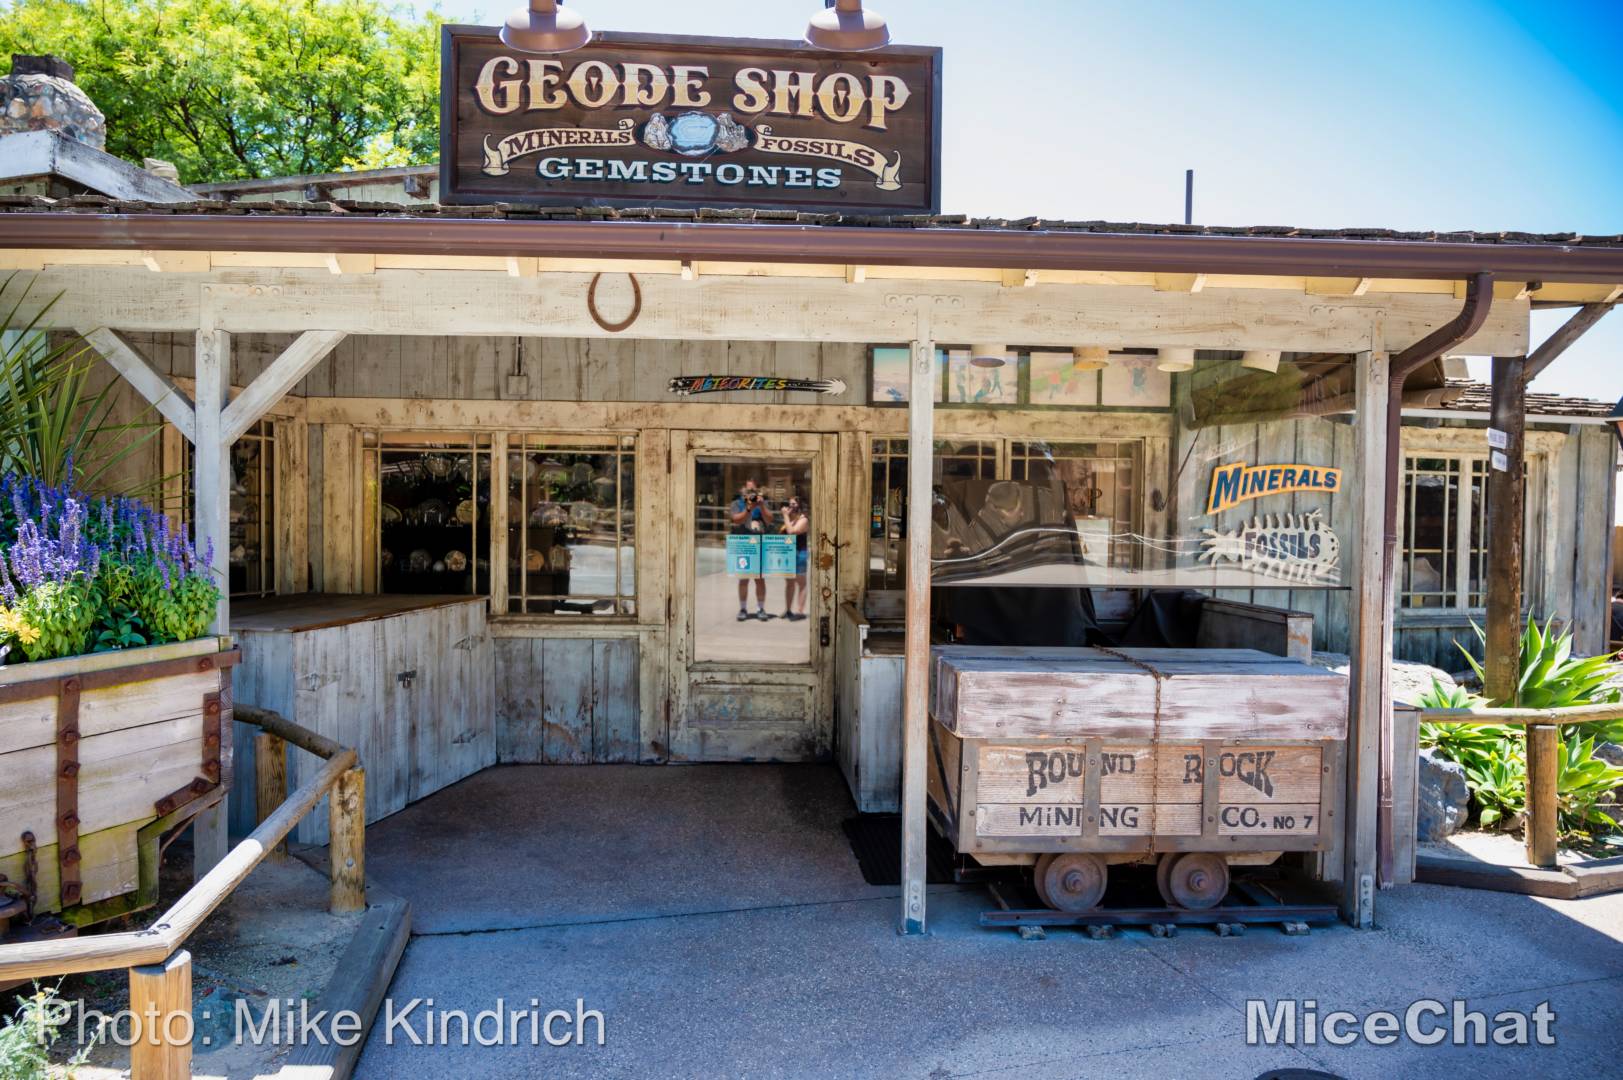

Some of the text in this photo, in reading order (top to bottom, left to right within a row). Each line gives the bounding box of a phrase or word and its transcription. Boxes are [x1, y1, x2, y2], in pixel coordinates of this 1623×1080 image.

[474, 56, 912, 130] GEODE SHOP
[505, 128, 632, 157] MINERALS
[760, 136, 877, 167] FOSSILS
[538, 156, 842, 189] GEMSTONES
[691, 376, 787, 391] METEORITES
[1212, 467, 1337, 509] MINERALS
[1244, 531, 1321, 561] FOSSILS
[1183, 751, 1276, 799] ROCK
[1221, 806, 1267, 828] CO.
[1303, 816, 1314, 829] 7
